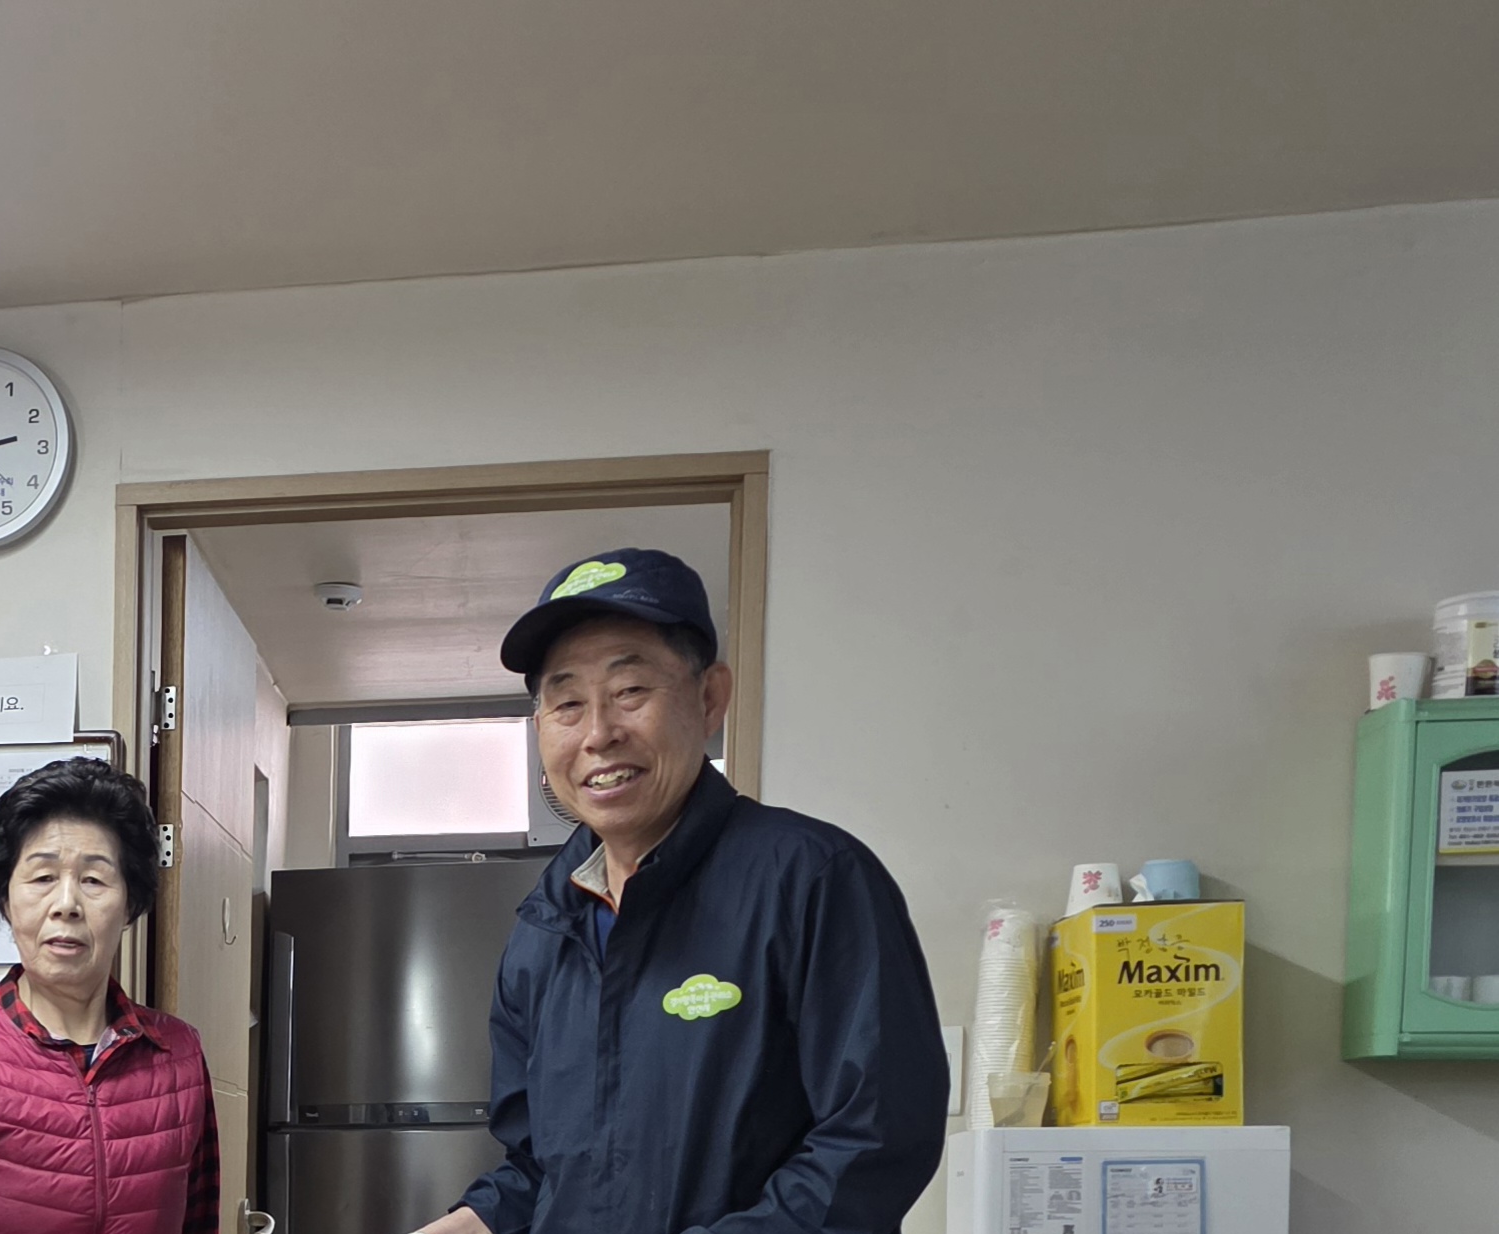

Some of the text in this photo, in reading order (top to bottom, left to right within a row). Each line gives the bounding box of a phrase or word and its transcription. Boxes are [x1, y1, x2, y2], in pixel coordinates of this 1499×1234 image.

[4, 382, 14, 397] 1
[28, 408, 40, 424] 2
[37, 439, 49, 455] 3
[26, 474, 40, 490] 4
[1, 500, 13, 516] 5
[1117, 954, 1221, 984] Maxim
